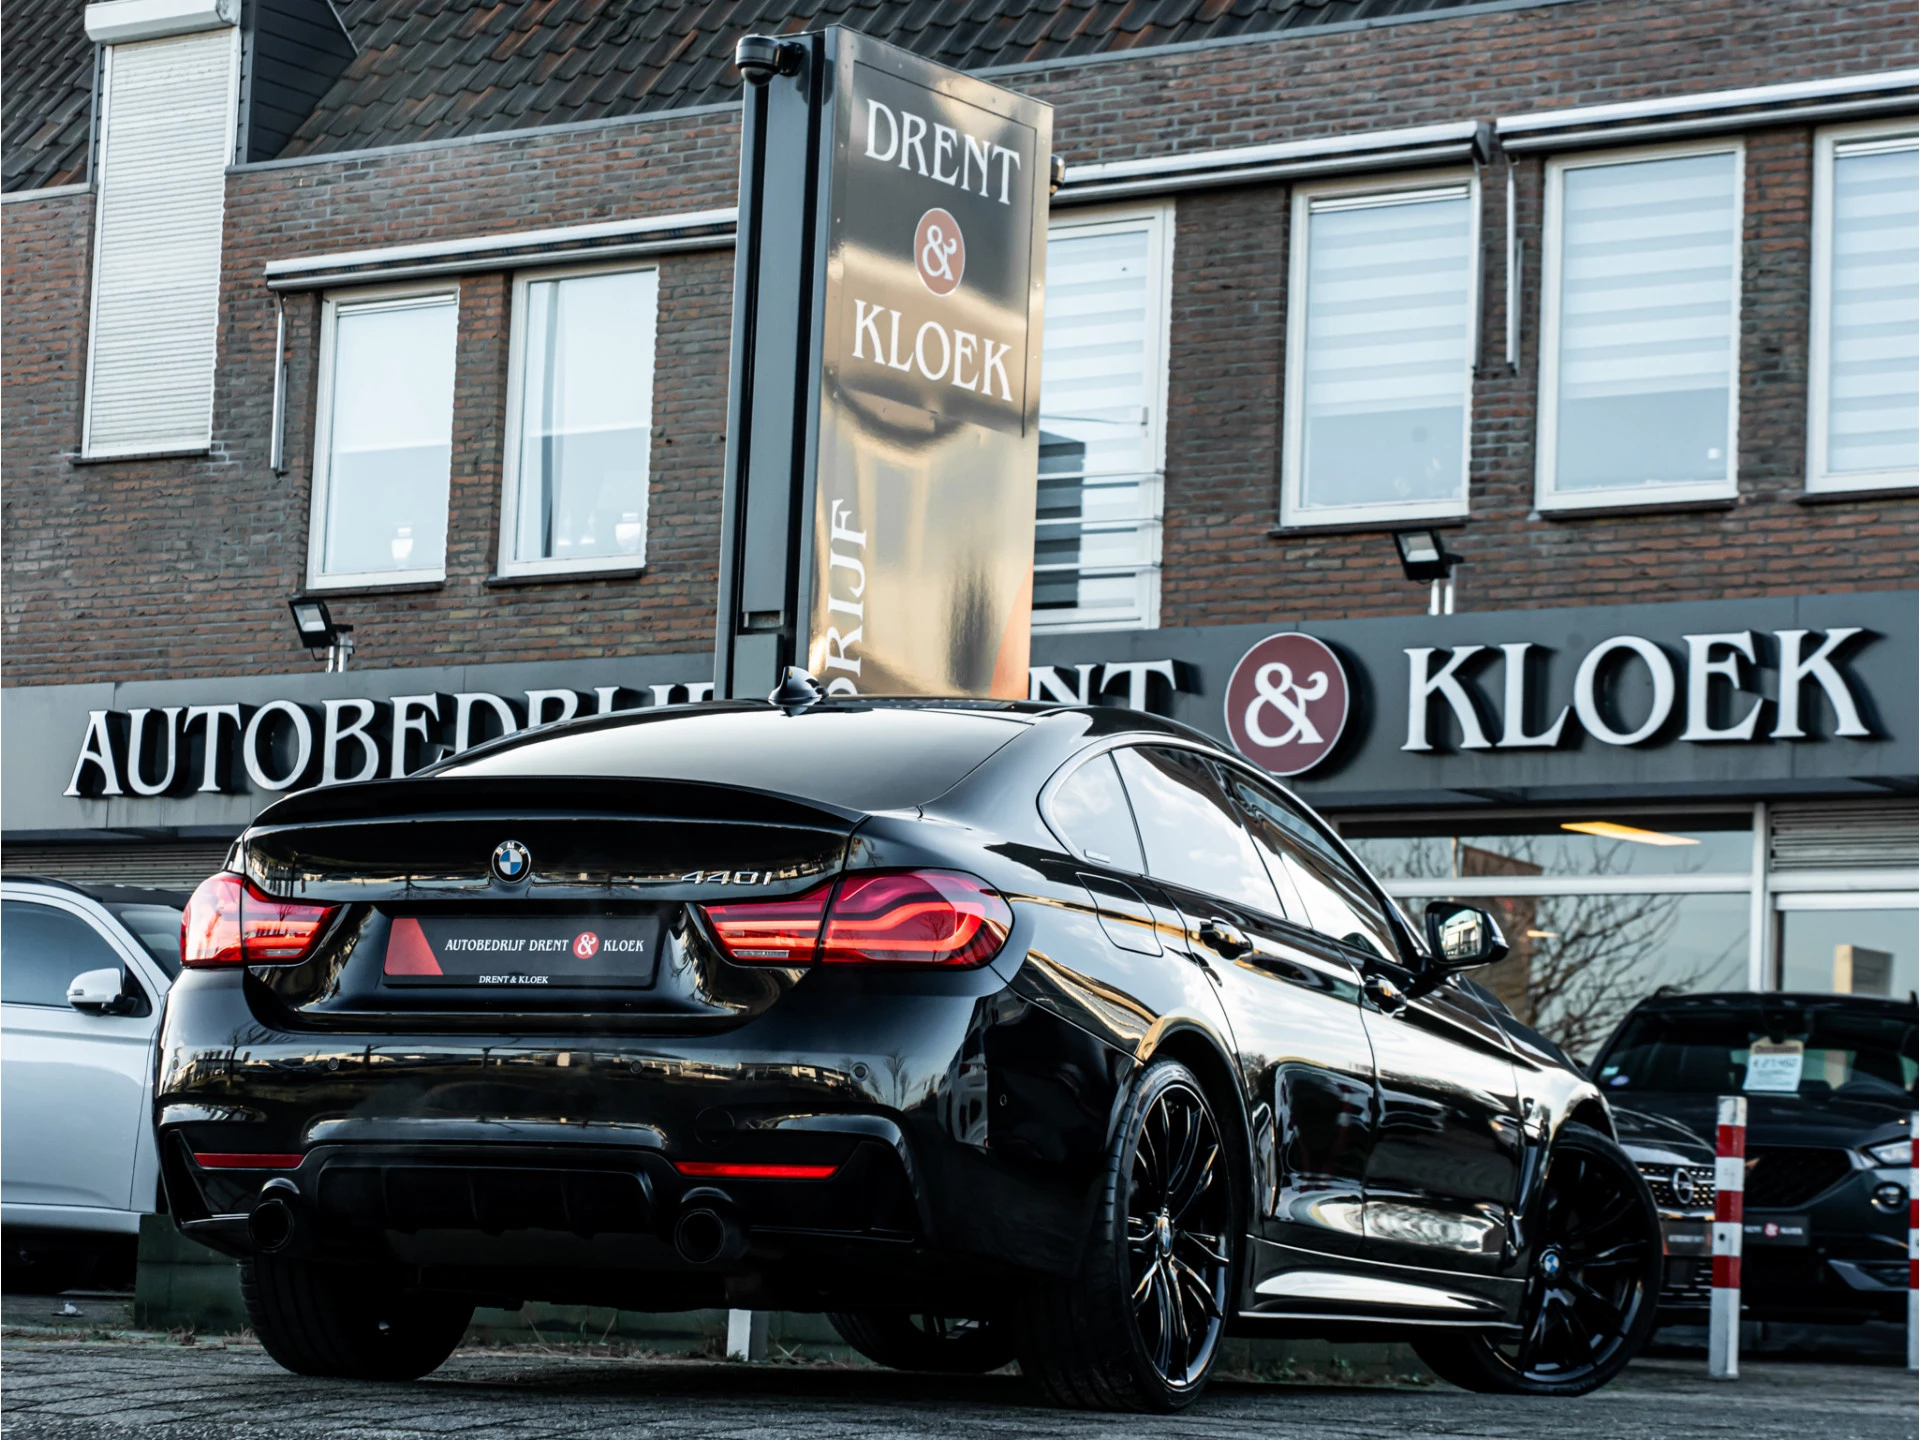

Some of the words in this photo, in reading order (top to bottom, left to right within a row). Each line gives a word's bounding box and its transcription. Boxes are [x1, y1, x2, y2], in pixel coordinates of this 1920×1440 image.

[864, 98, 1021, 205] DRENT
[922, 224, 957, 281] &
[852, 299, 1013, 402] KLOEK
[1244, 662, 1329, 747] &
[1400, 627, 1871, 751] KLOEK
[445, 939, 526, 951] AUTOBEDRIJF
[529, 939, 569, 951] DRENT
[577, 934, 596, 955] &
[603, 940, 645, 952] KLOEK
[479, 975, 509, 984] DRENT
[509, 975, 517, 984] &
[518, 975, 549, 984] KLOEK
